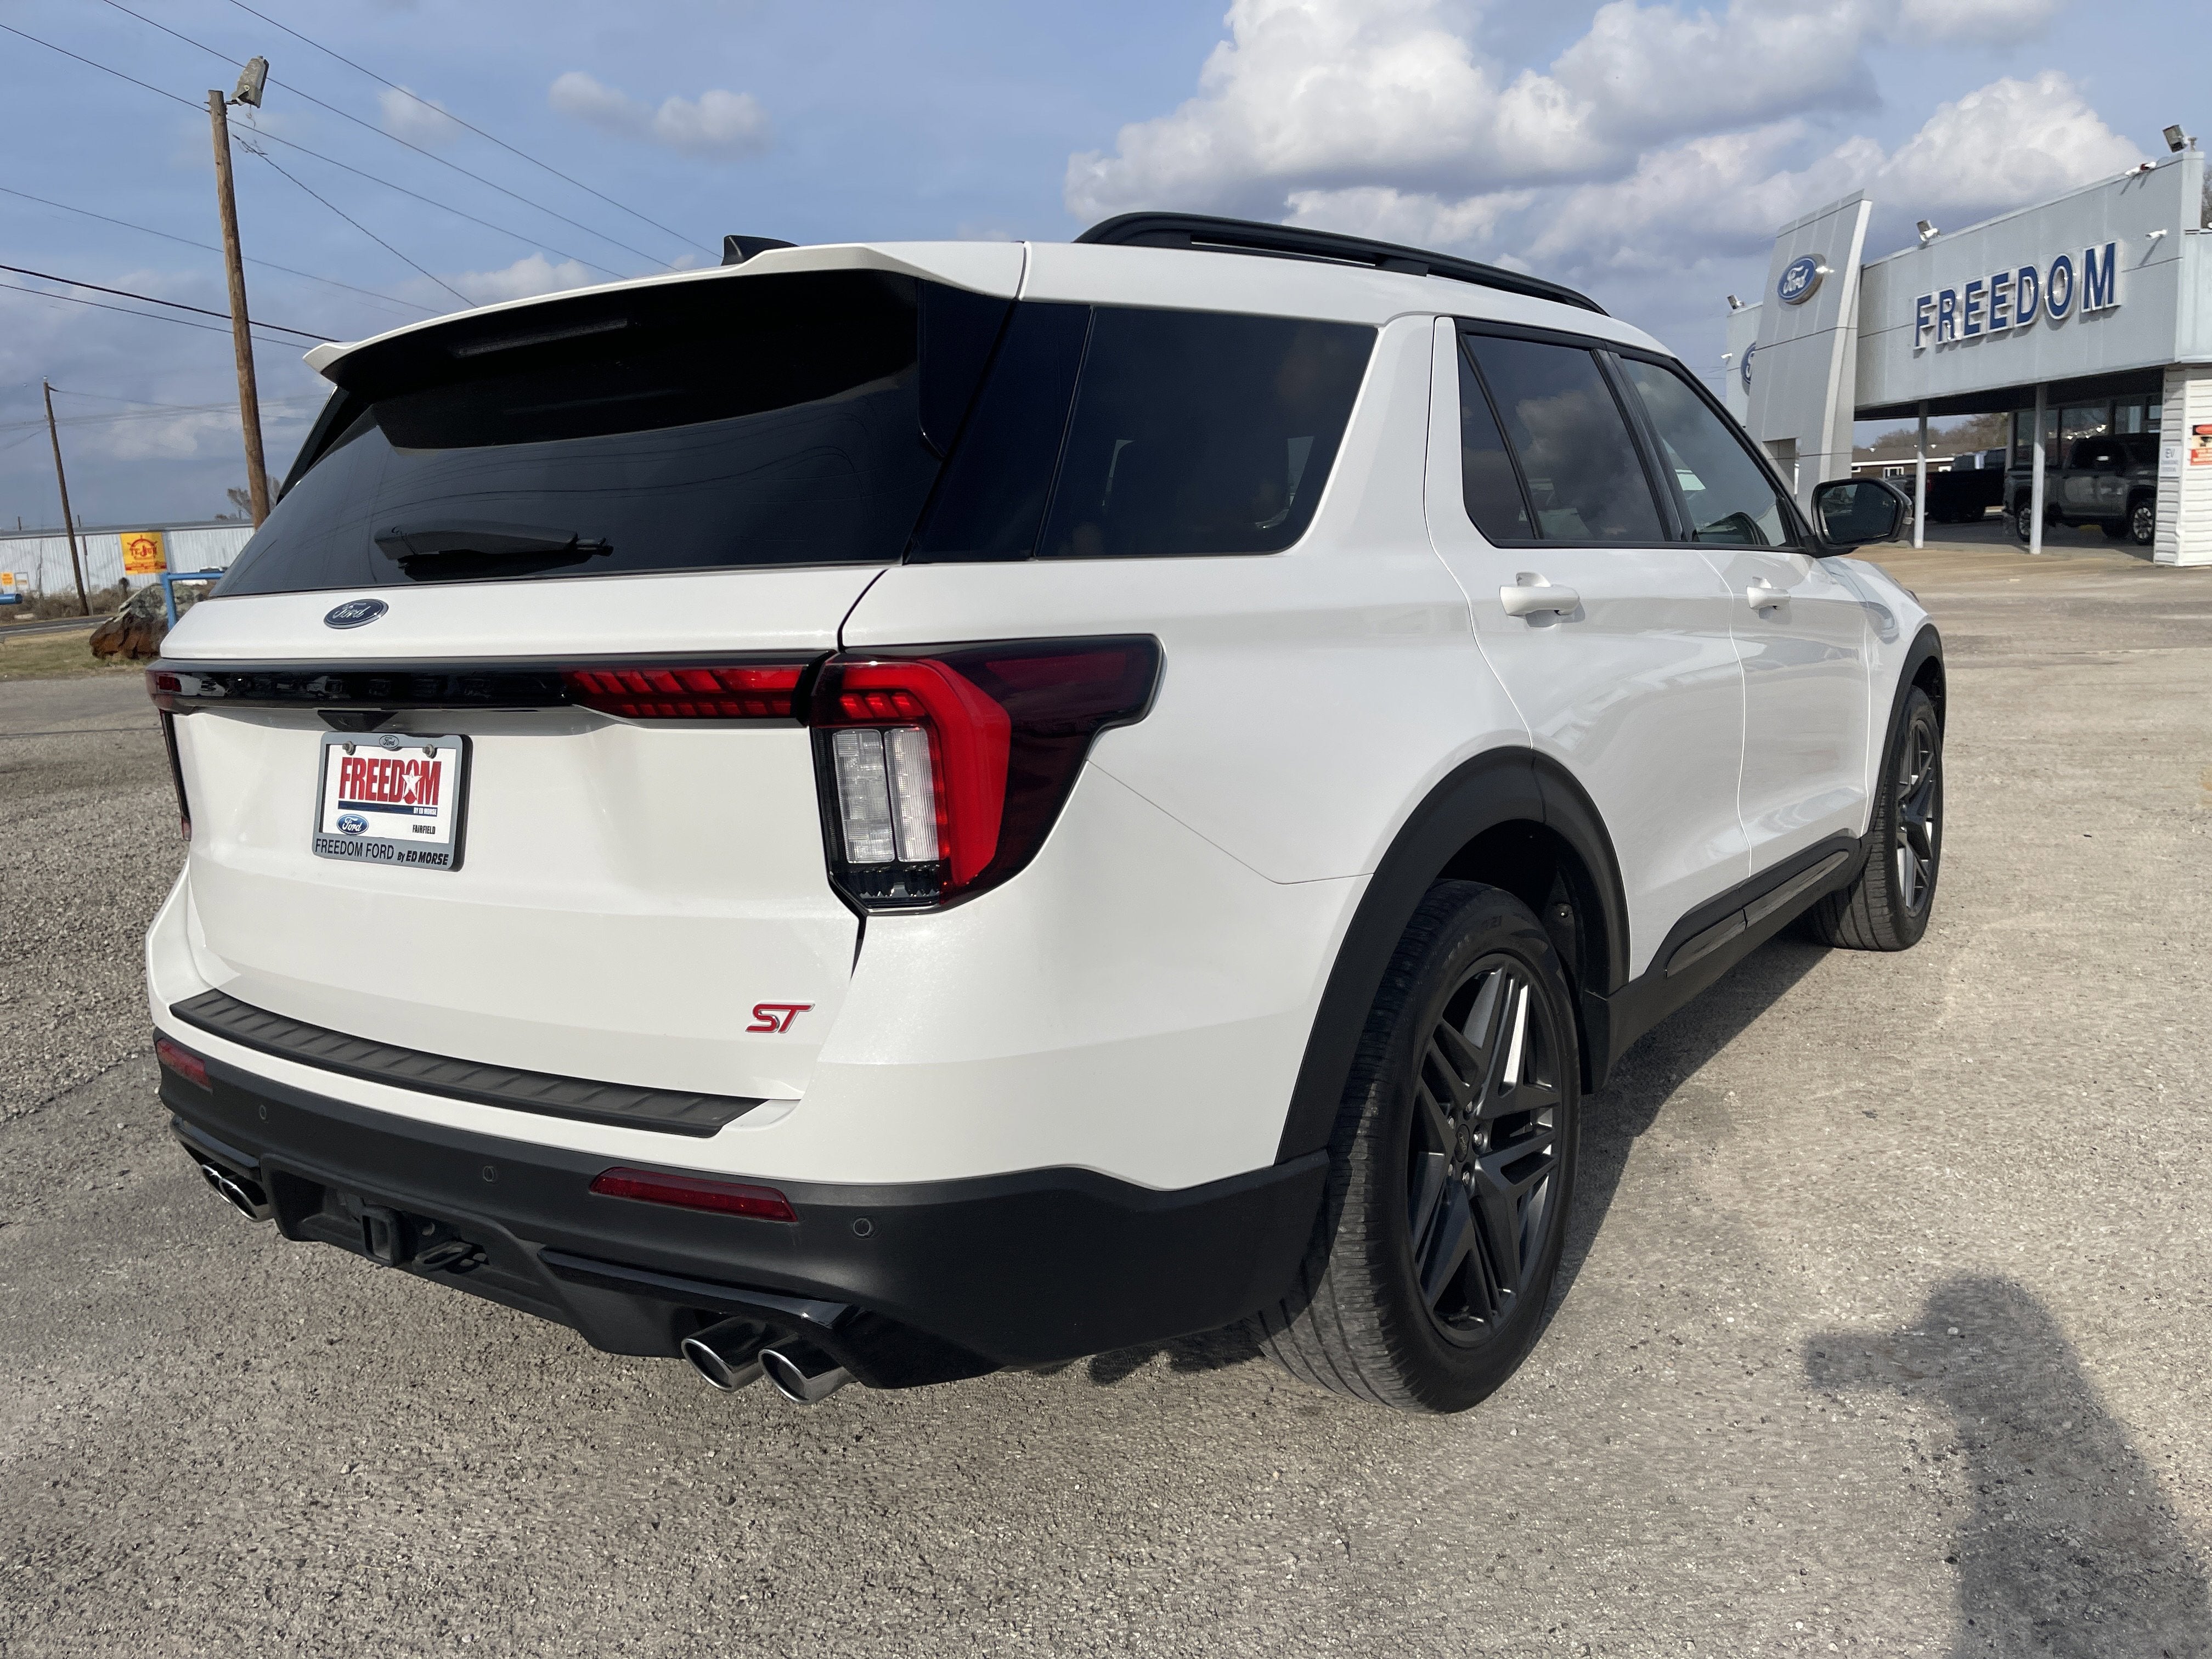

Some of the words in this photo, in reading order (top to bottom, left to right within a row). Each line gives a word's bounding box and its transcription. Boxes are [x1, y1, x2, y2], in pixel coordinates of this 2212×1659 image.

[1782, 266, 1809, 294] Ford
[1914, 241, 2119, 349] FREEDOM
[332, 603, 371, 619] Ford
[383, 736, 396, 746] Ford
[338, 757, 442, 805] FREEDOM
[342, 817, 363, 832] Ford
[412, 825, 436, 834] FAIRFIELD
[315, 839, 363, 856] FREEDOM
[366, 843, 394, 859] FORD
[397, 851, 405, 862] By
[406, 850, 417, 862] ED
[417, 851, 449, 866] MORSE
[745, 1003, 816, 1034] ST
